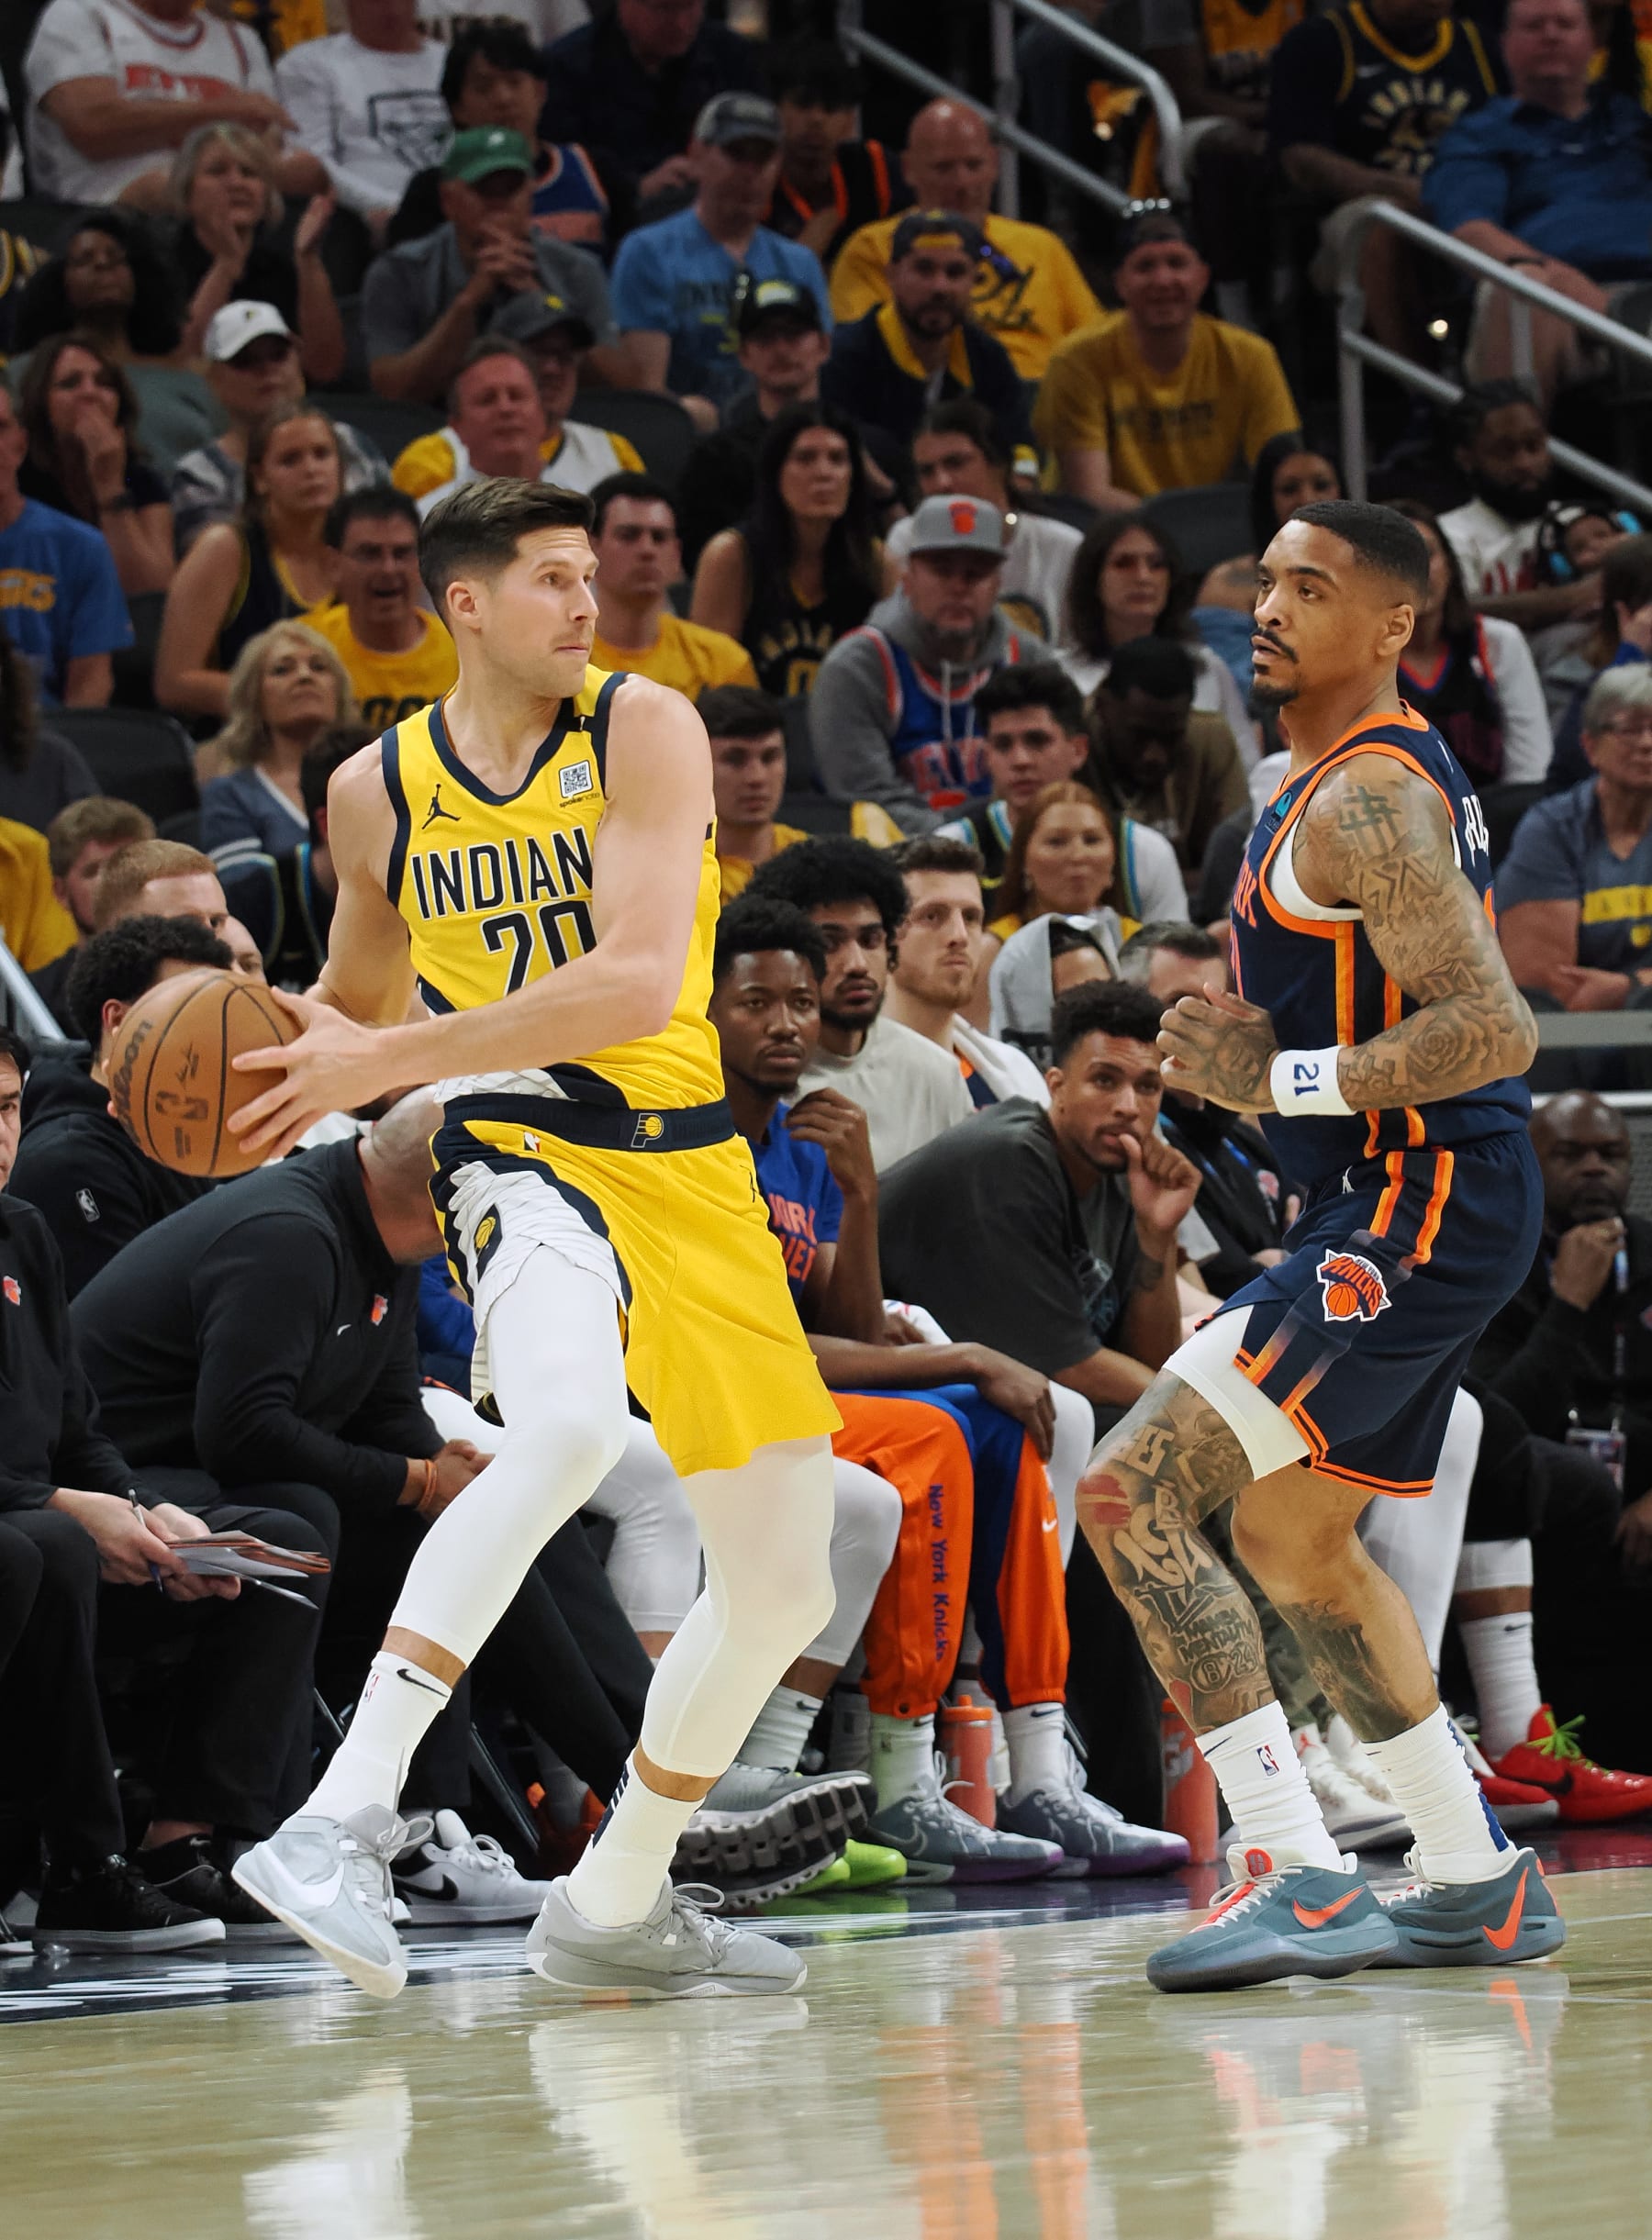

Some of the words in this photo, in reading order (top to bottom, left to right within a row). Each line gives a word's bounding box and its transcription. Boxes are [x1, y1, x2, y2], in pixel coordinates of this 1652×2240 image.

[559, 791, 601, 809] spokenote
[409, 823, 595, 921] INDIAN
[479, 898, 599, 997] 20
[1293, 1062, 1320, 1098] 21
[1320, 1254, 1384, 1317] KNICKS
[929, 1483, 943, 1529] New
[931, 1538, 947, 1584] York
